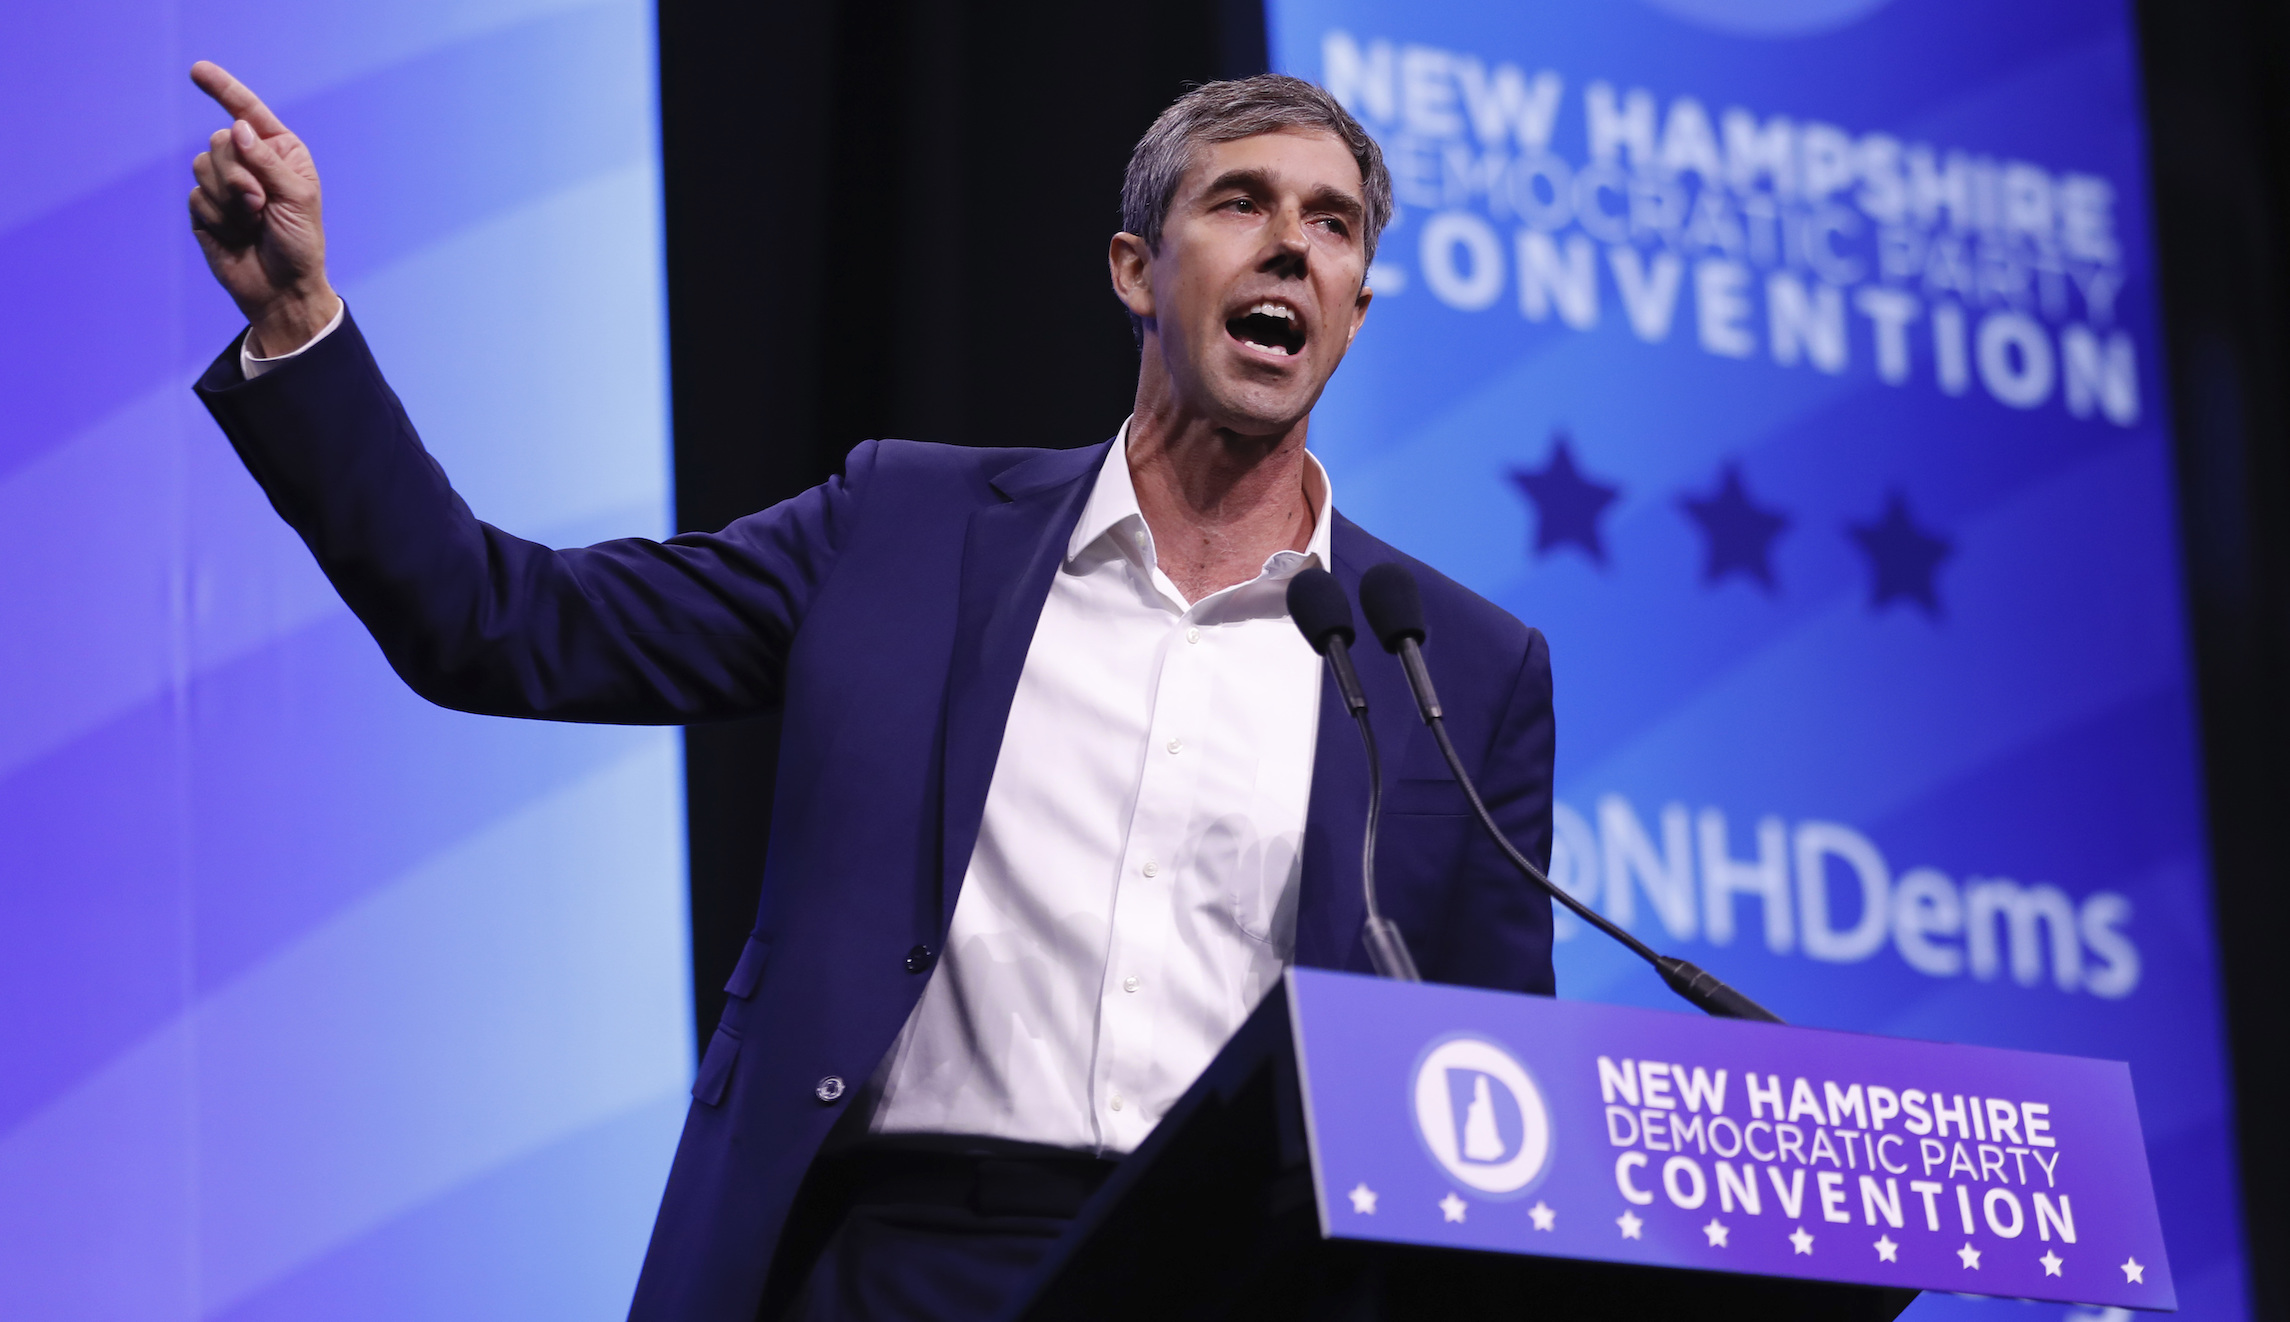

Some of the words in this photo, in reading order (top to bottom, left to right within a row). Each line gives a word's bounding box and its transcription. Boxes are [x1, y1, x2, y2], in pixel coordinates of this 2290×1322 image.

[1323, 32, 1562, 152] NEW
[1586, 80, 2118, 264] HAMPSHIRE
[1382, 132, 1868, 287] EMOCRATIC
[1876, 224, 2125, 327] PARTY
[1364, 210, 2139, 427] ONVENTION
[1597, 1055, 1727, 1115] NEW
[1746, 1072, 2056, 1148] HAMPSHIRE
[1605, 1105, 1908, 1175] DEMOCRATIC
[1920, 1138, 2060, 1188] PARTY
[1614, 1151, 2077, 1245] CONVENTION
